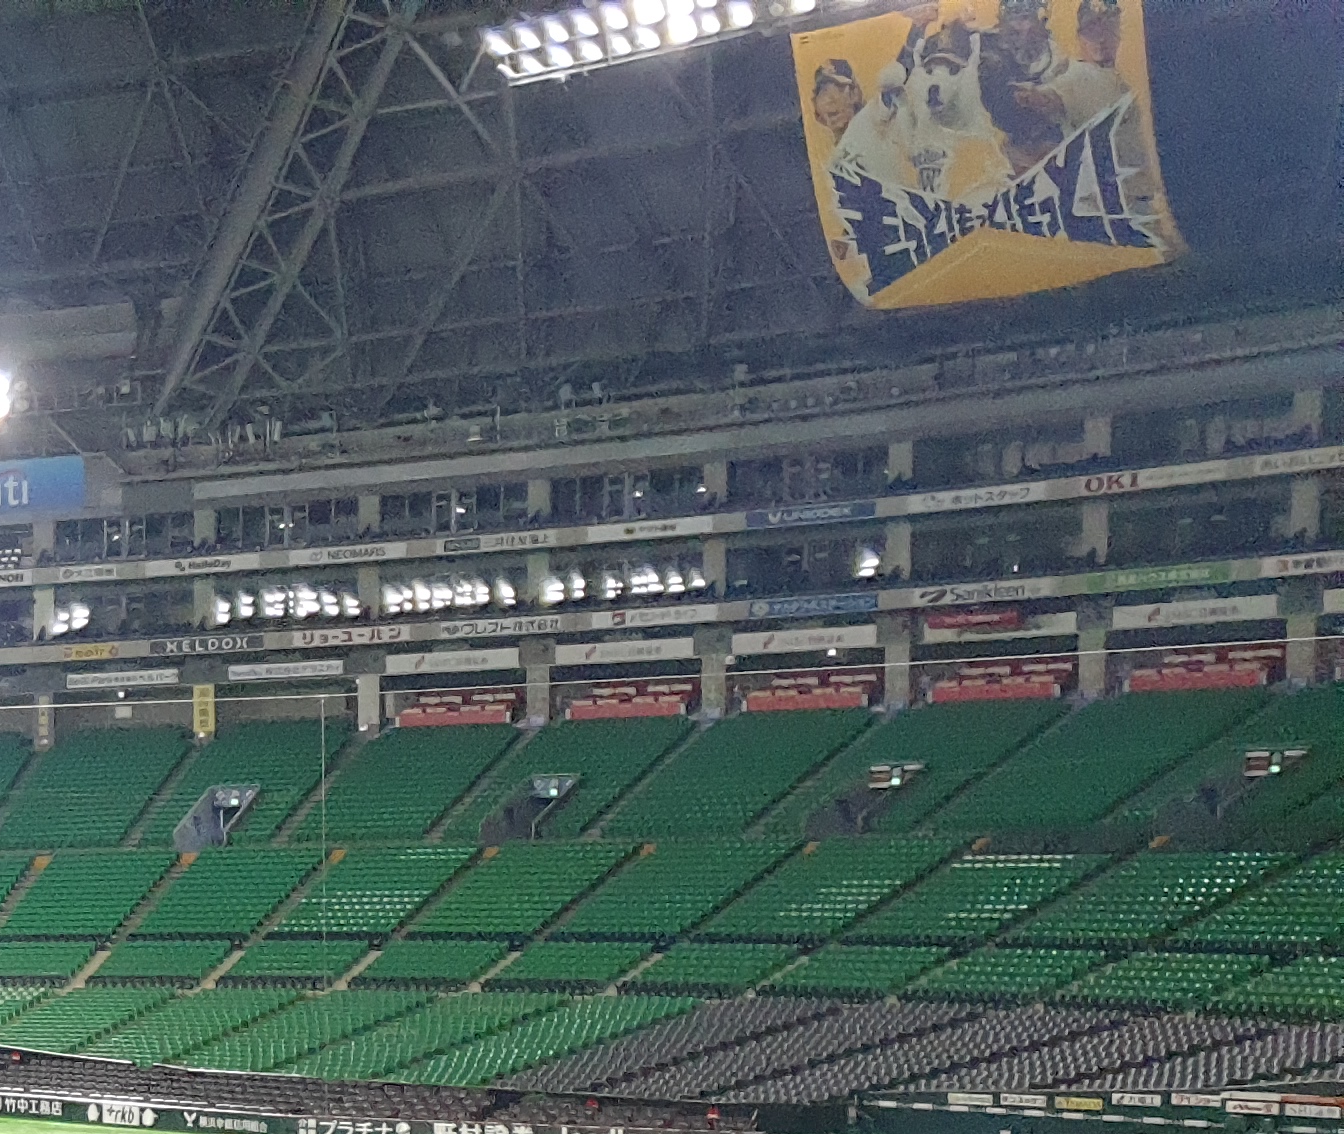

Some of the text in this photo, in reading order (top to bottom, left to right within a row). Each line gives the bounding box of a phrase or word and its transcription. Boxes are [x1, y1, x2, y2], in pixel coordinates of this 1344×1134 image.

[1084, 472, 1140, 494] OKI
[4, 1098, 63, 1116] 竹中工務店
